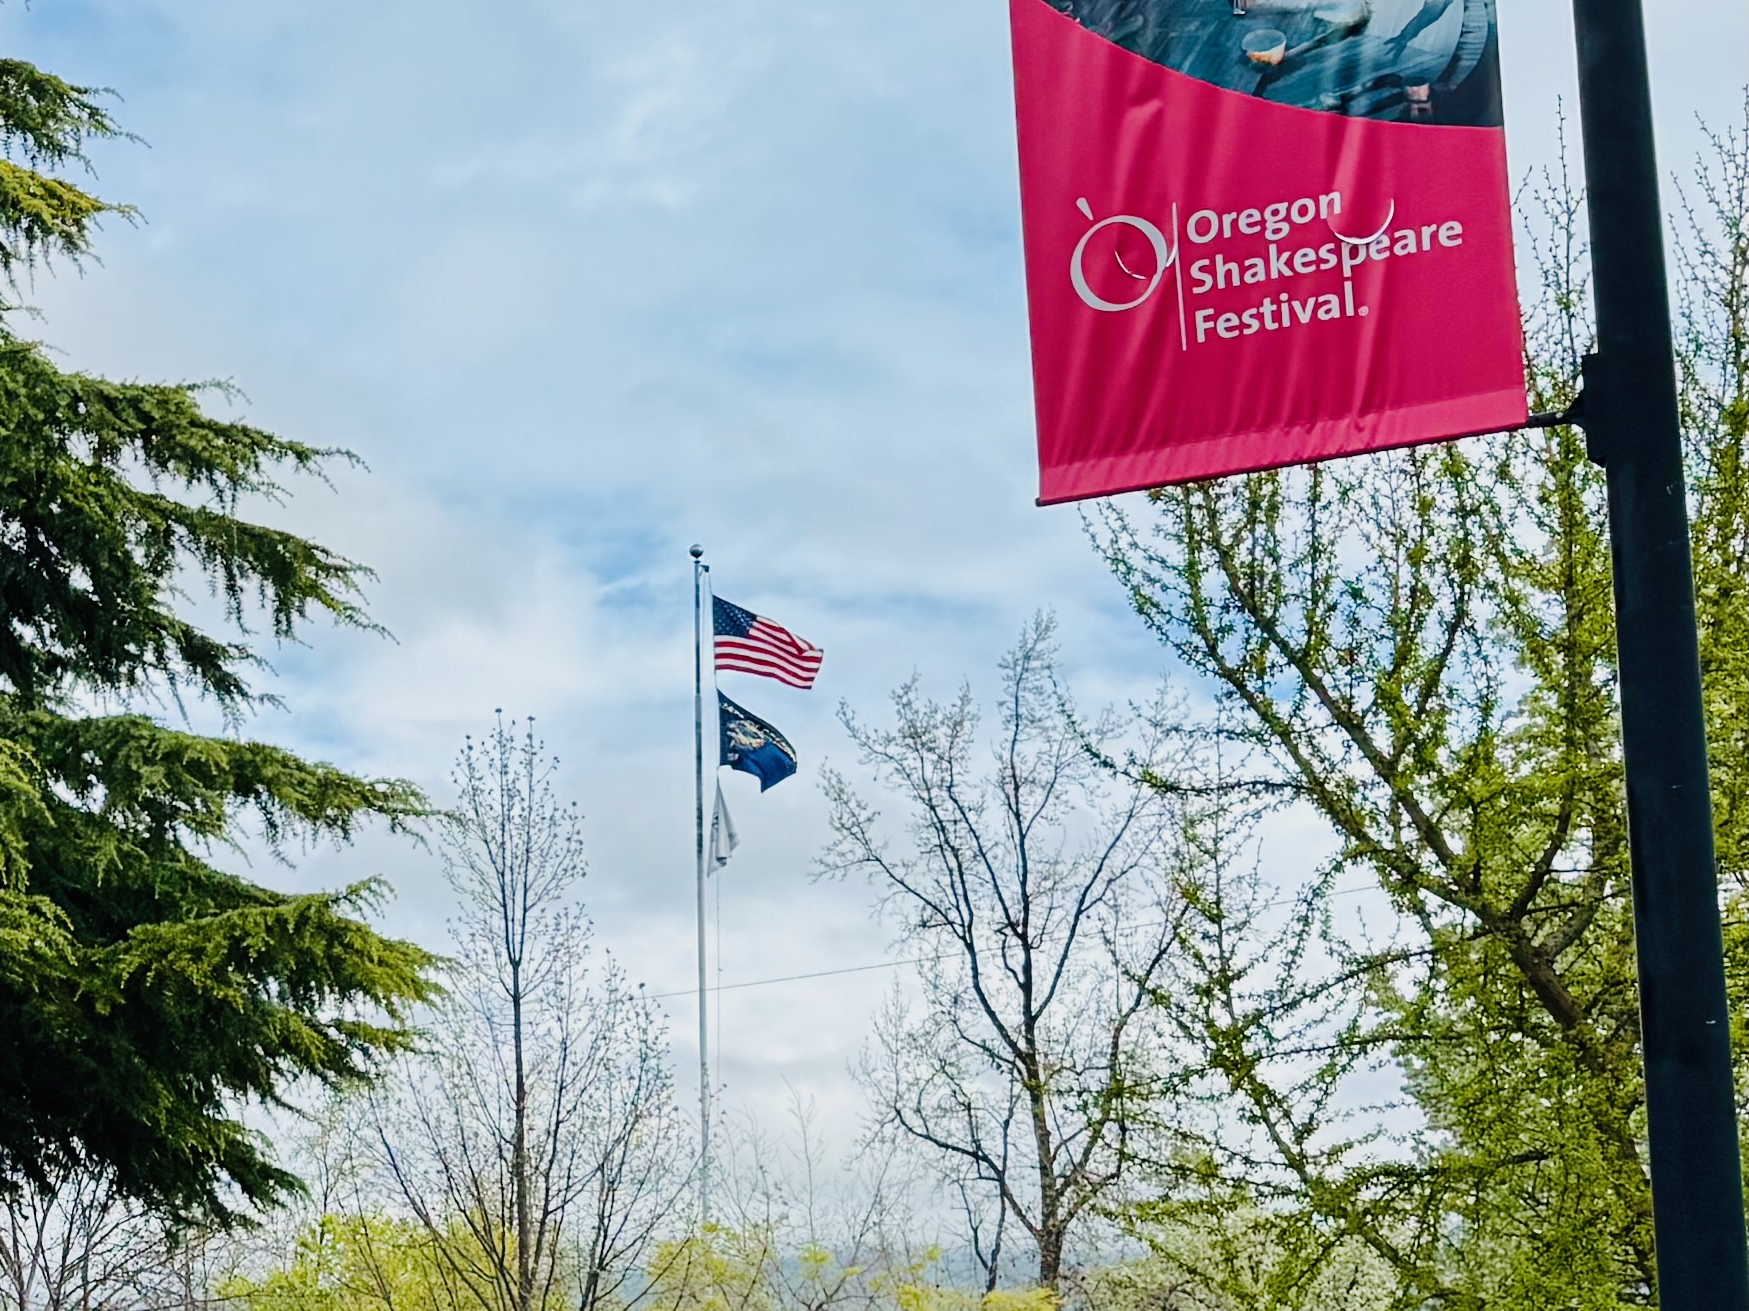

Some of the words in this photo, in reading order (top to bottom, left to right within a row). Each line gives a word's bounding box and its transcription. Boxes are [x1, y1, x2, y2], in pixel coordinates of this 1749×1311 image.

[1186, 190, 1342, 244] Oregon
[1189, 219, 1464, 294] Shakespeare
[1194, 280, 1355, 344] Festival
